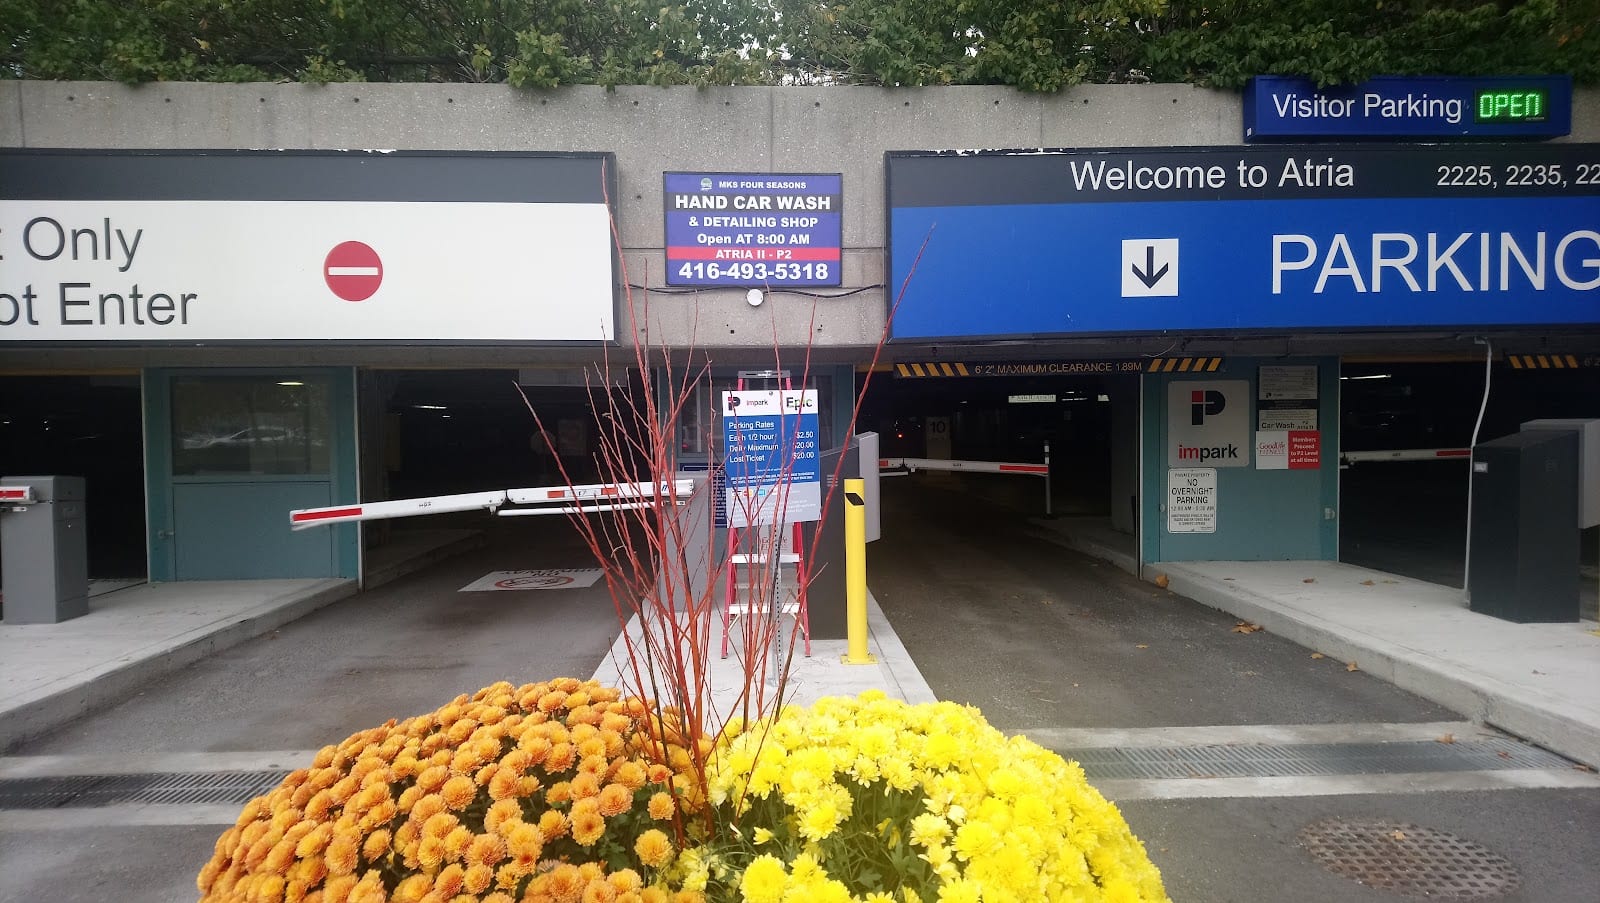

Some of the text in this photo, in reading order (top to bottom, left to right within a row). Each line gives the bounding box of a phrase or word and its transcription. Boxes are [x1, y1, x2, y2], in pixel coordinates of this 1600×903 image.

[1272, 93, 1463, 125] Visitor Parking
[1480, 94, 1540, 117] OPEN
[1070, 157, 1355, 191] Welcome to Atria
[1437, 165, 1498, 188] 2225,
[1505, 164, 1568, 187] 2235,
[719, 181, 806, 189] MKS FOUR SEASONS
[675, 195, 831, 210] HAND CAR WASH
[688, 216, 818, 228] & DETAILING SHOP
[23, 216, 143, 272] Only
[697, 233, 810, 247] Open AT 8:00 AM
[716, 249, 753, 259] ATRIA
[776, 250, 792, 259] P2
[1272, 230, 1600, 295] PARKING
[679, 261, 828, 280] 416-493-5318
[59, 282, 198, 326] Enter
[997, 364, 1047, 374] MAXIMUM
[1050, 362, 1113, 373] CLEARANCE
[786, 396, 813, 411] Epic
[728, 421, 775, 431] Parking Rates
[930, 420, 946, 433] 10
[1261, 421, 1295, 429] Car Wash
[760, 433, 775, 441] hour
[747, 443, 779, 452] Maximum
[1178, 443, 1239, 463] impark
[745, 454, 765, 462] Ticket
[1187, 478, 1198, 487] NO
[1171, 487, 1214, 495] OVERNIGHT
[1176, 496, 1209, 504] PARKING
